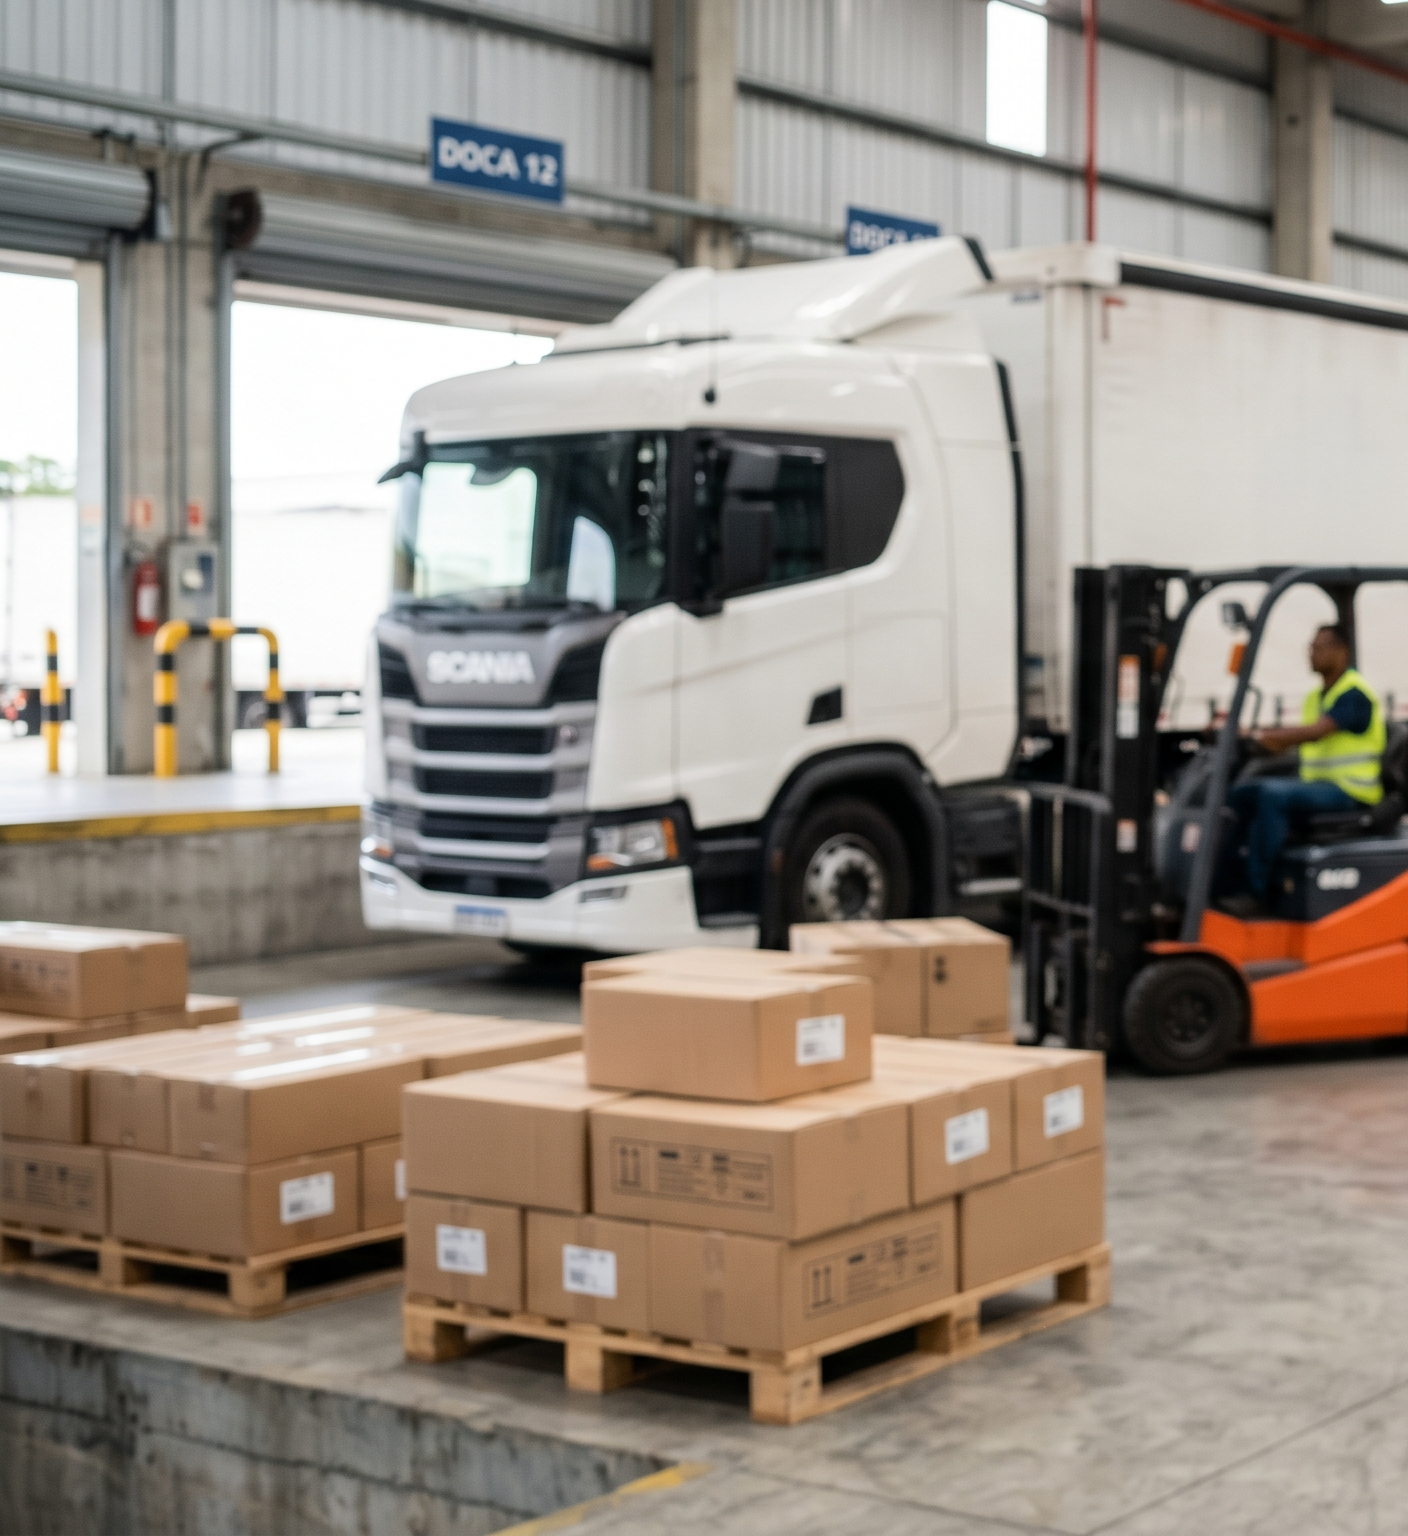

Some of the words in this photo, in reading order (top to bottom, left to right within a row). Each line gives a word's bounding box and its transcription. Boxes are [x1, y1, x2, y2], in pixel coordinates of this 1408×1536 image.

[438, 136, 521, 181] DOCA
[523, 152, 559, 187] 12
[426, 650, 536, 684] SCANIA
